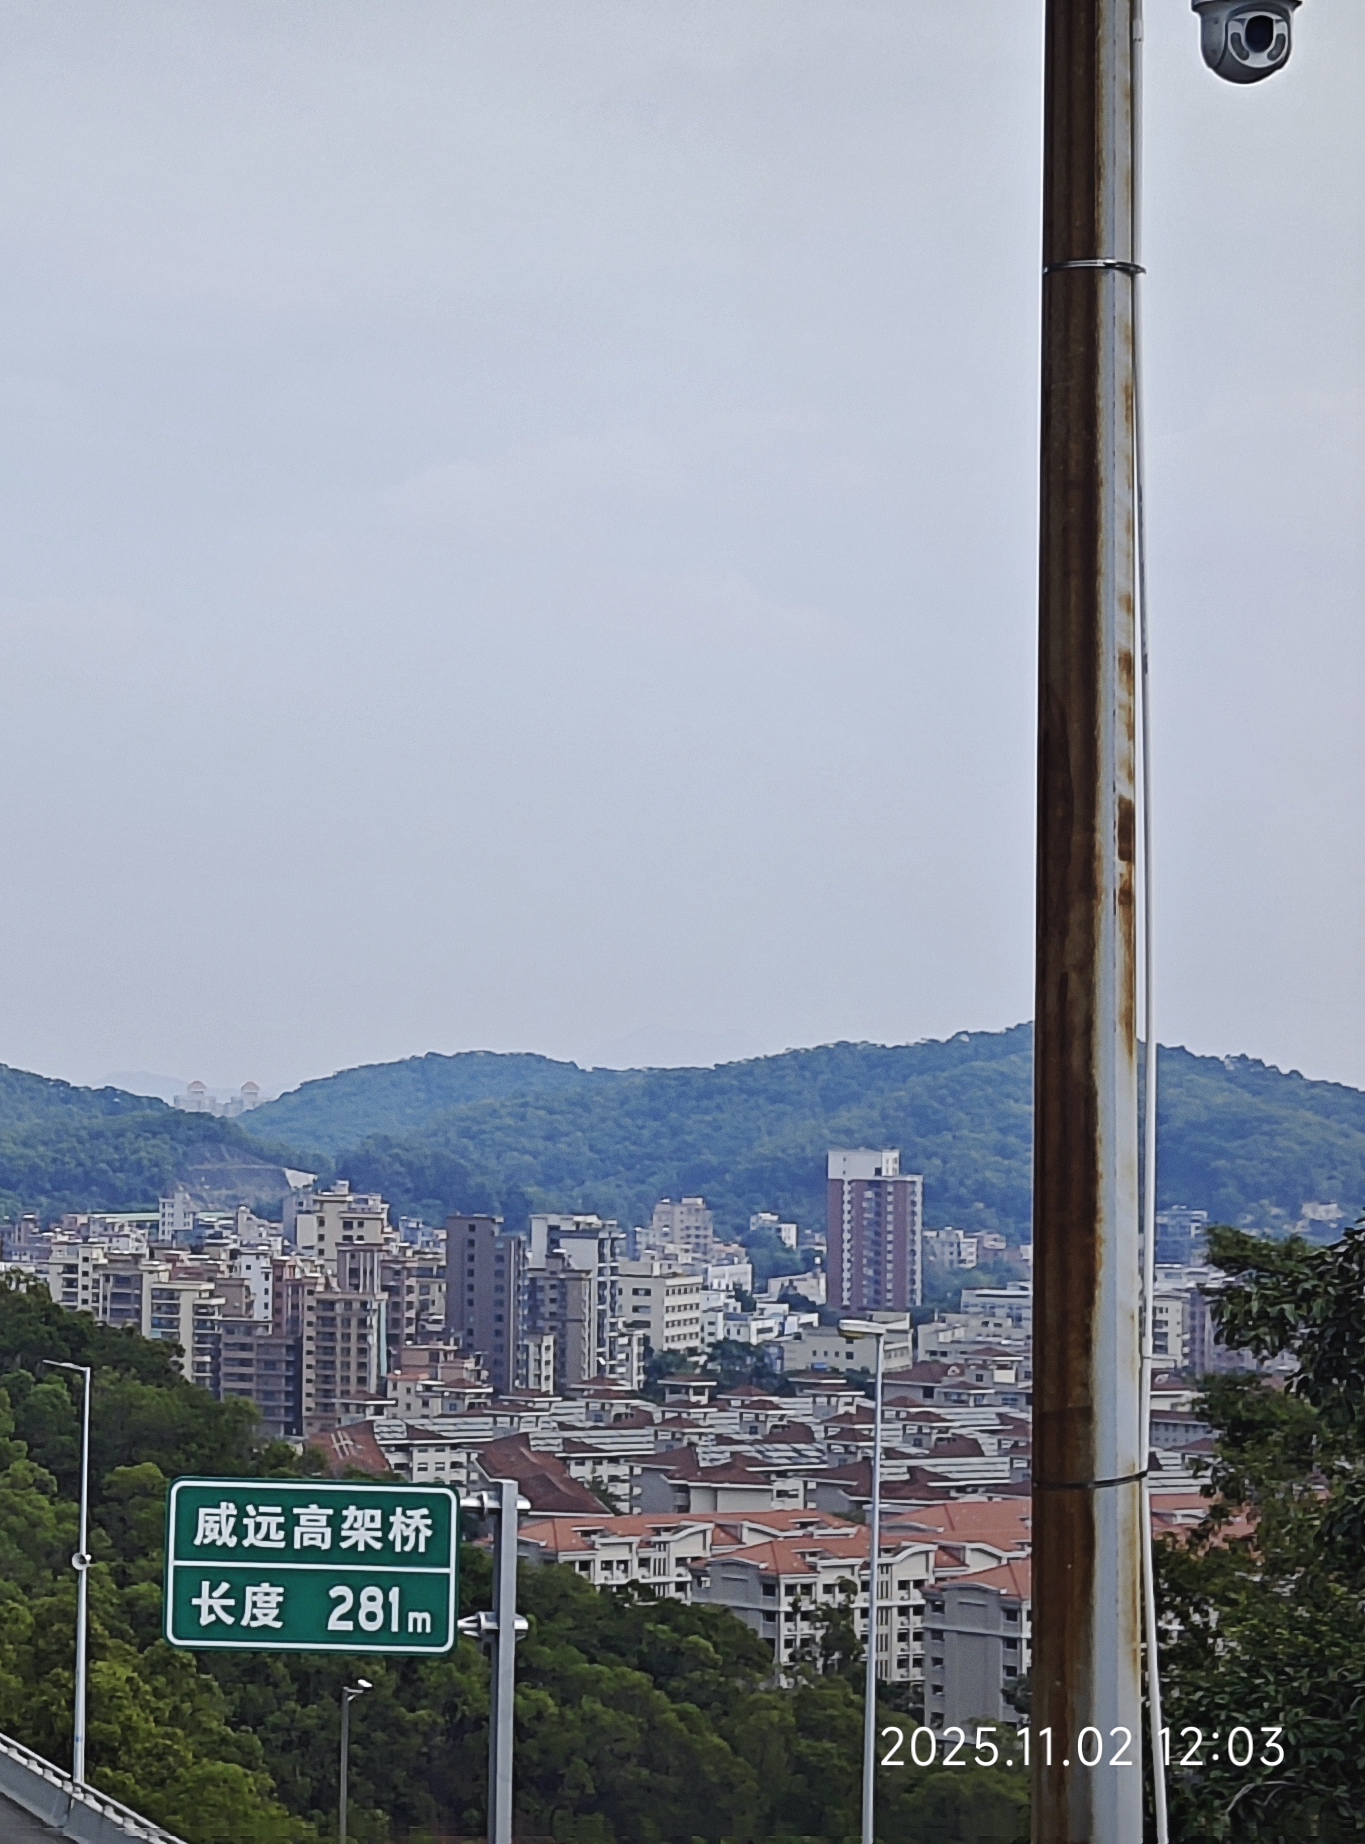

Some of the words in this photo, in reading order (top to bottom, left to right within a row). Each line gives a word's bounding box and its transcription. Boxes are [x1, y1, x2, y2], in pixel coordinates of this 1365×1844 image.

[193, 1501, 433, 1553] 威远高架桥
[191, 1580, 285, 1629] 长度
[327, 1585, 431, 1634] 281m
